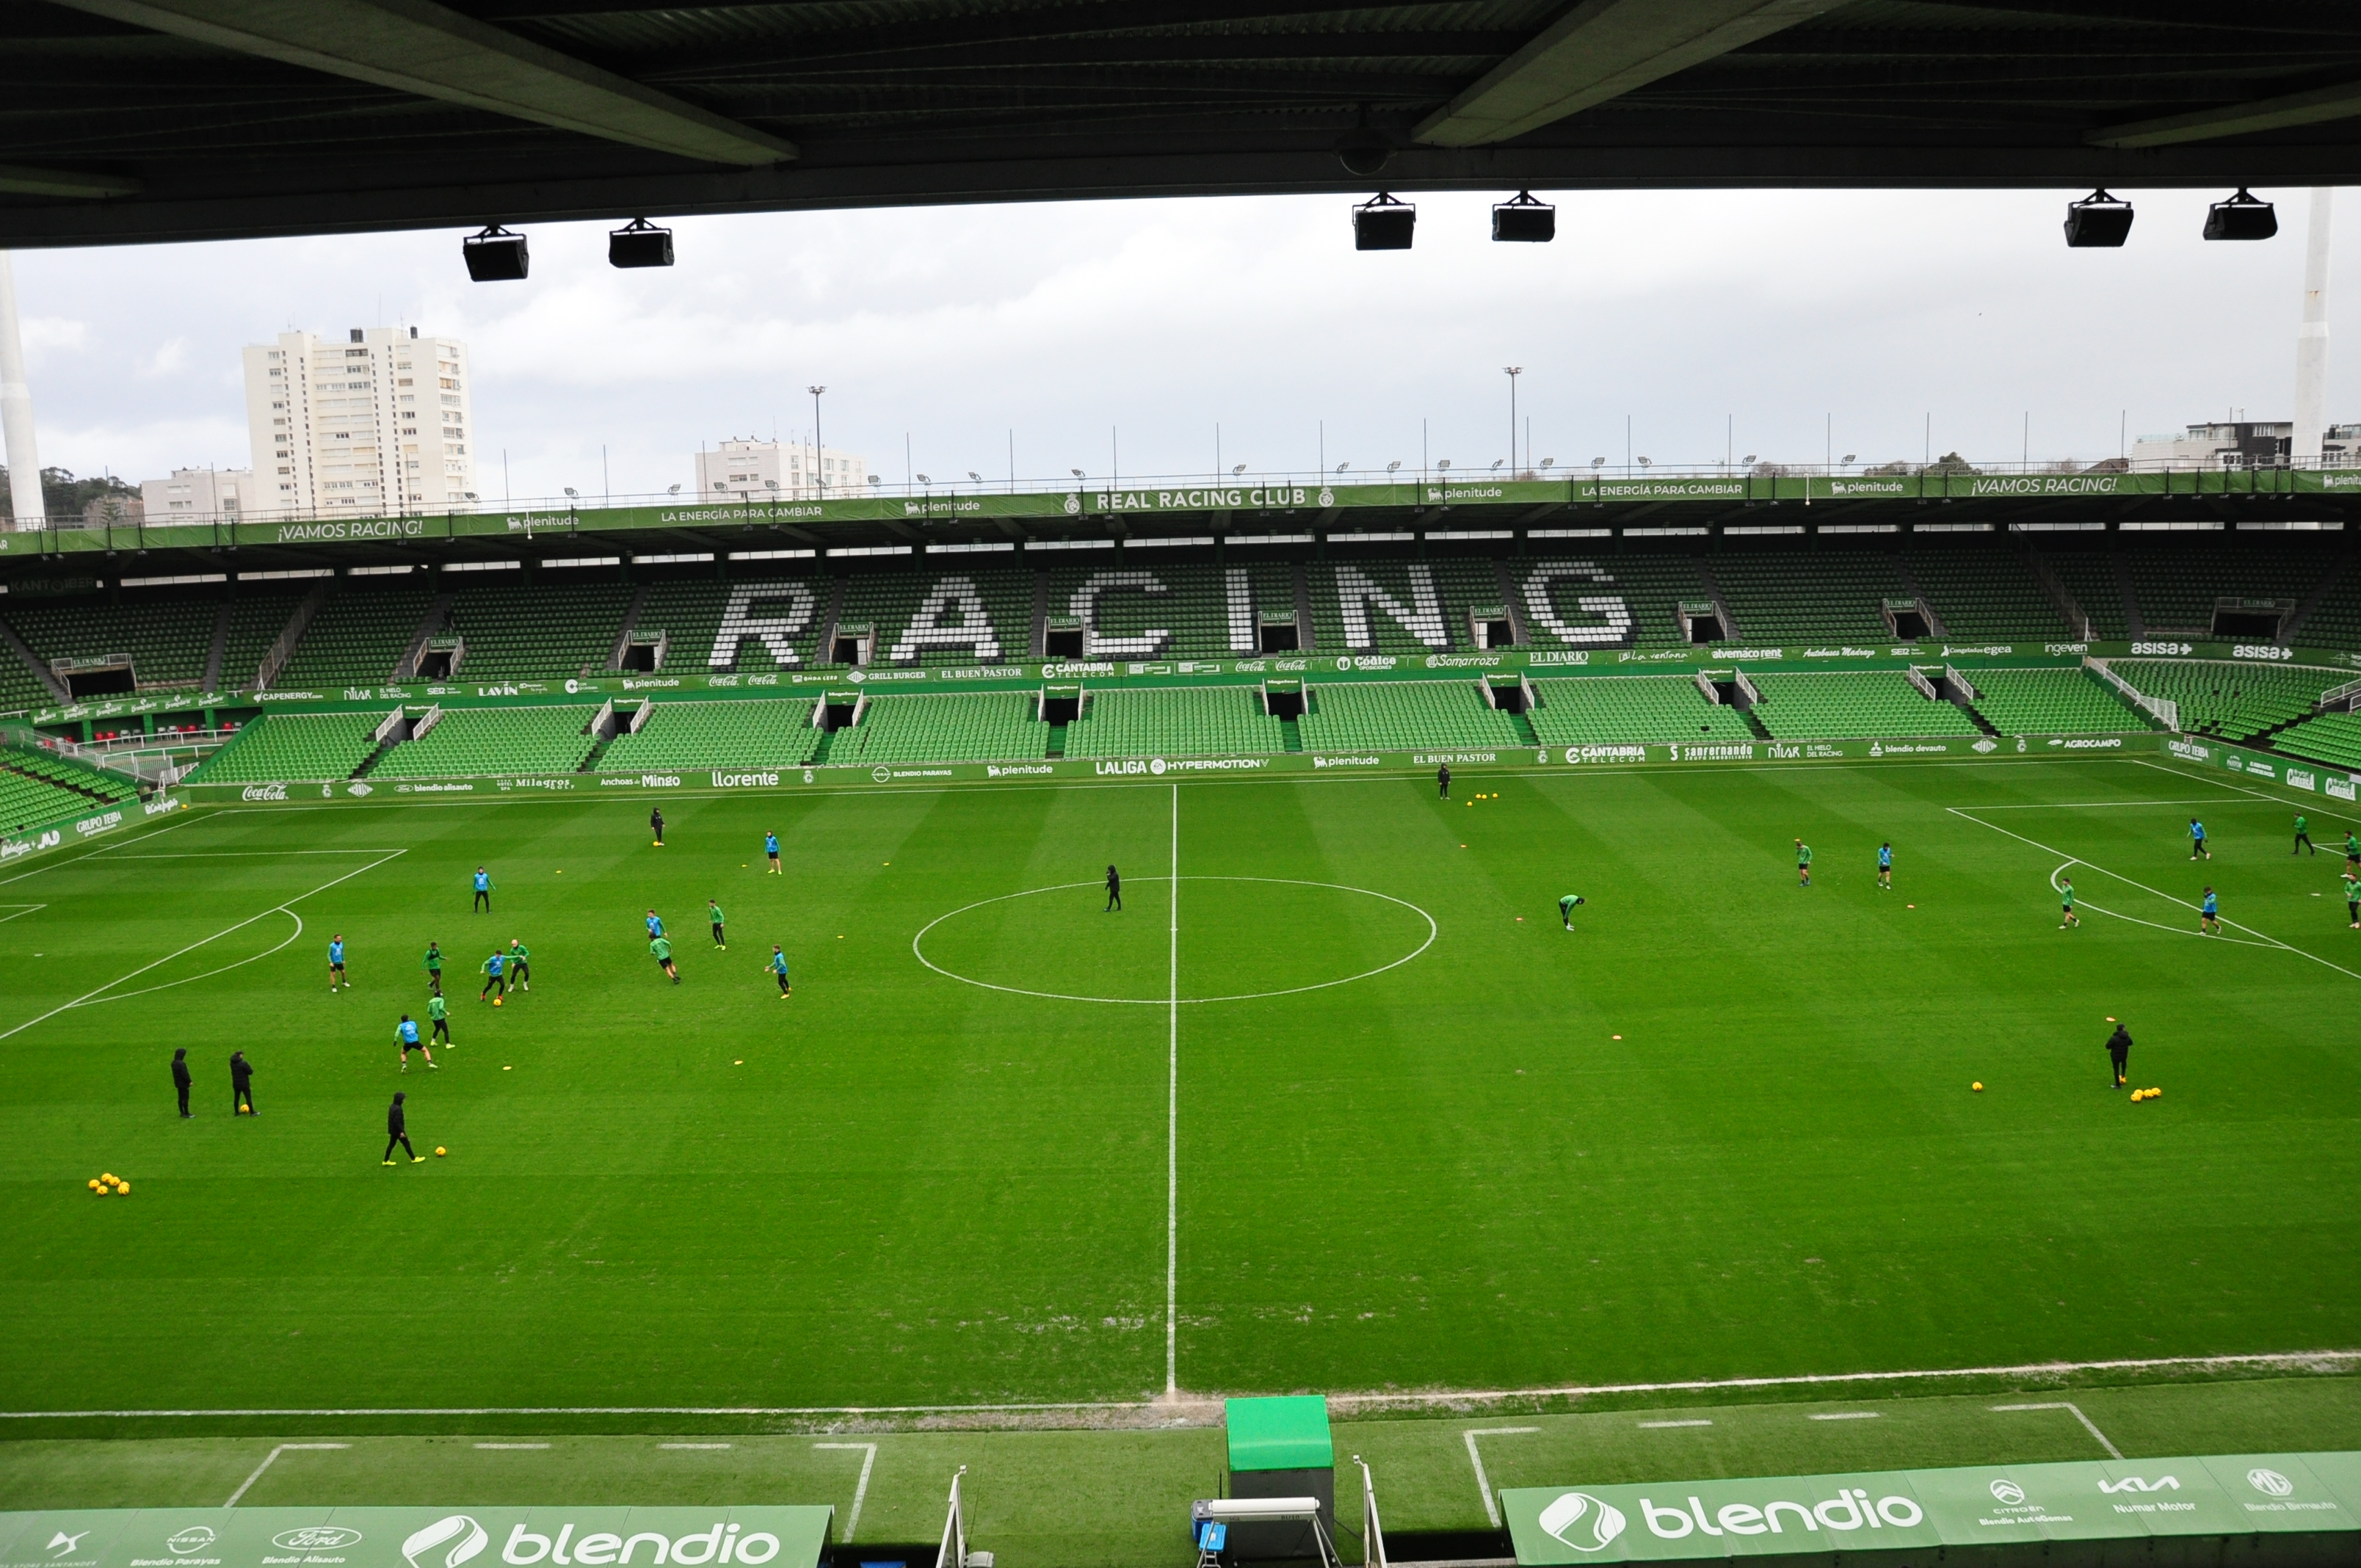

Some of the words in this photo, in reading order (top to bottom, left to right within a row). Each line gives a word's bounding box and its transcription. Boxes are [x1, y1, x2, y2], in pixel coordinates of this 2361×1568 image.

[1582, 487, 1597, 496] LA
[1600, 484, 1651, 496] ENERGÍA
[1654, 485, 1686, 495] PARA
[1689, 484, 1743, 495] CAMBIAR
[1848, 482, 1903, 494] plenitude
[1972, 479, 2041, 496] ¡VAMOS
[2045, 477, 2117, 493] RACING!
[1097, 493, 1151, 509] REAL
[1159, 490, 1242, 507] RACING
[1250, 488, 1306, 505] CLUB
[1445, 487, 1503, 500] plenitude
[922, 501, 980, 514] plenitude
[661, 512, 676, 522] LA
[679, 508, 730, 520] ENERGÍA
[733, 509, 766, 519] PARA
[768, 507, 822, 518] CAMBIAR
[523, 515, 579, 529] plenitude
[278, 523, 346, 542] ¡VAMOS
[351, 520, 423, 537] RACING!
[1711, 648, 1760, 658] alvemaco
[1760, 647, 1782, 658] rent
[1803, 647, 1840, 658] Autobuses
[1983, 645, 2012, 656] egea
[2045, 642, 2088, 656] ingeven
[2131, 642, 2179, 655] asisa
[2233, 645, 2280, 659] asisa
[1437, 655, 1500, 667] Somarroza
[1529, 651, 1546, 661] EL
[1547, 651, 1589, 661] DIARIO
[1631, 650, 1646, 660] La
[1650, 650, 1689, 659] ventana
[941, 669, 954, 678] EL
[955, 669, 981, 678] BUEN
[983, 668, 1022, 677] PASTOR
[1056, 662, 1114, 672] CANTABRIA
[636, 679, 680, 689] plenitude
[1885, 744, 1914, 752] blendio
[1915, 744, 1946, 752] devauto
[2064, 738, 2122, 749] AGROCAMPO
[2168, 740, 2191, 753] GRUPO
[2191, 743, 2209, 758] TEIBA
[1413, 755, 1426, 763] EL
[1427, 754, 1454, 763] BUEN
[1457, 753, 1496, 763] PASTOR
[1581, 747, 1645, 757] CANTABRIA
[1096, 761, 1147, 774] LALIGA
[1328, 756, 1379, 768] plenitude
[1002, 764, 1053, 776] plenitude
[515, 778, 570, 788] Milagros
[601, 778, 634, 786] Anchoas
[642, 774, 681, 787] Mingo
[712, 771, 779, 787] llorente
[414, 783, 443, 792] blendio
[443, 783, 474, 791] alisauto
[76, 816, 103, 833] GRUPO
[103, 810, 123, 825] TEIBA
[2113, 1503, 2156, 1514] Numar
[2156, 1502, 2196, 1511] Motor
[2244, 1502, 2285, 1511] Blendio
[2285, 1501, 2337, 1511] Birmauto
[1639, 1488, 1923, 1539] blendio
[1979, 1517, 2015, 1525] Blendio
[2017, 1514, 2073, 1523] AutoGomas
[501, 1523, 780, 1565] blendio
[130, 1558, 174, 1567] Blendio
[174, 1558, 222, 1567] Parayas
[261, 1556, 300, 1564] Blendio
[302, 1556, 345, 1564] Alisauto
